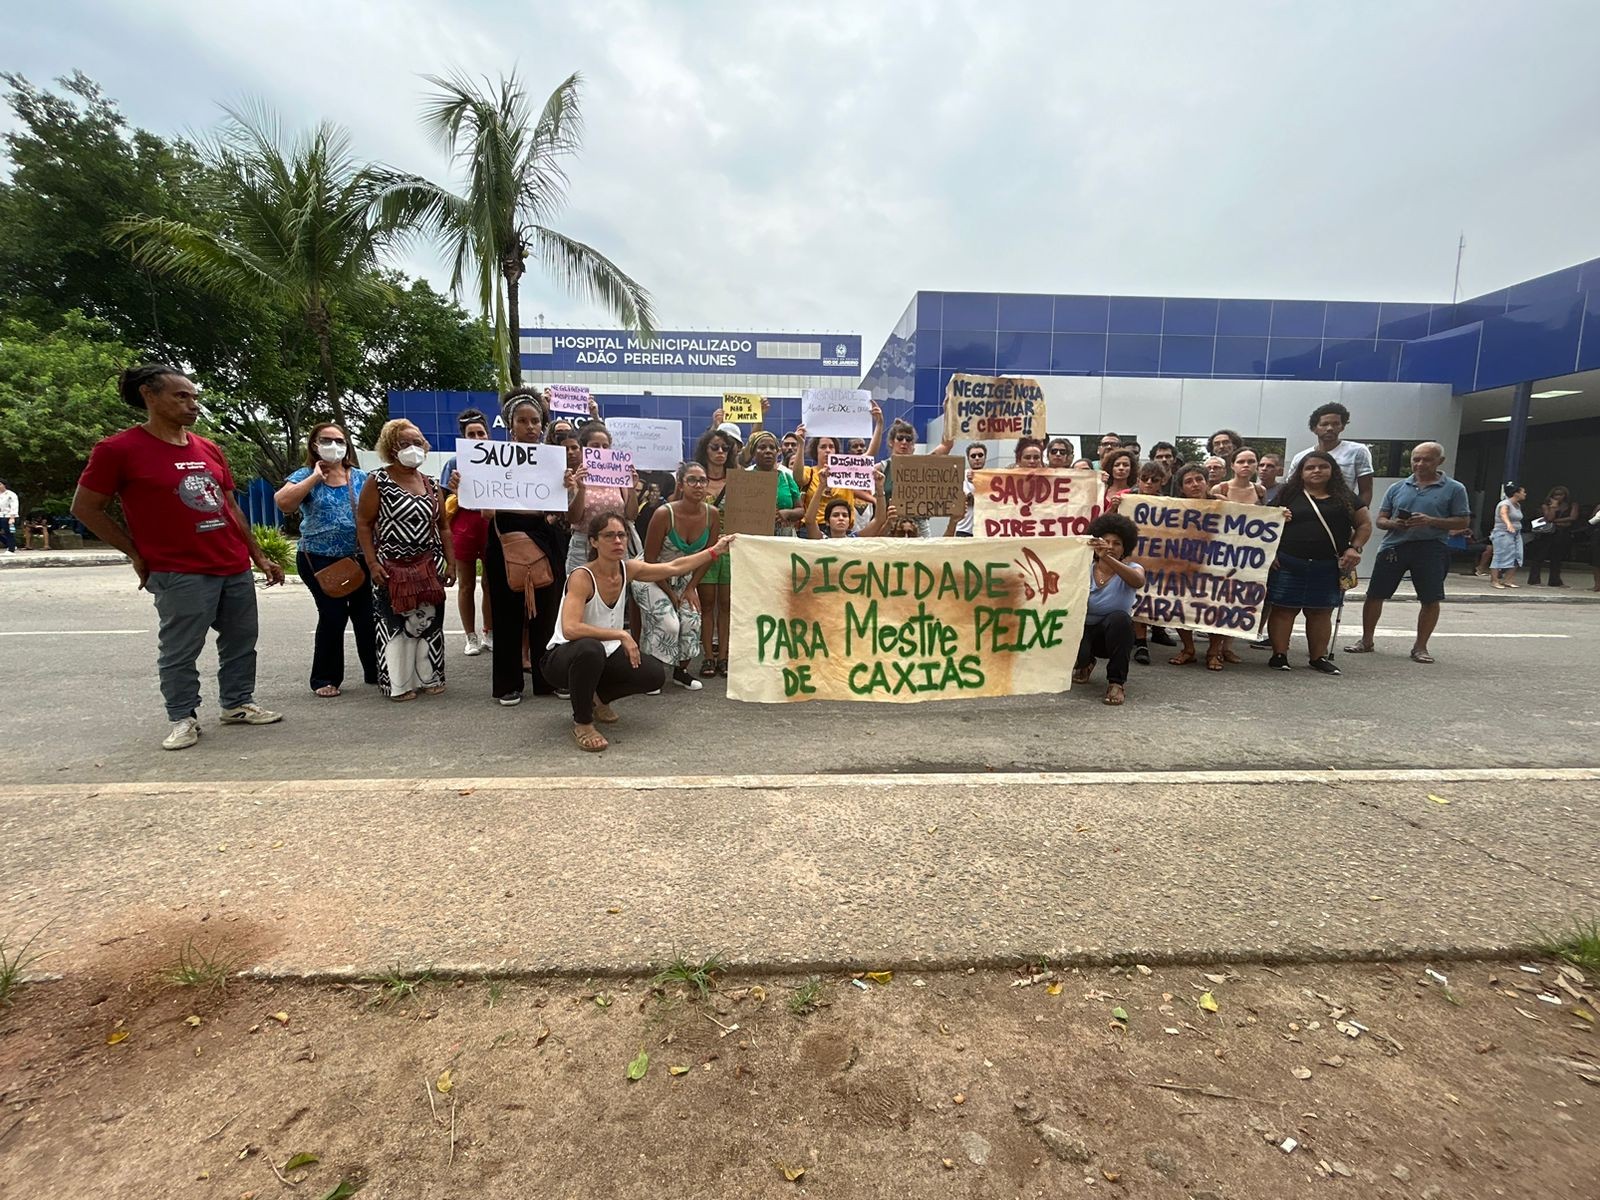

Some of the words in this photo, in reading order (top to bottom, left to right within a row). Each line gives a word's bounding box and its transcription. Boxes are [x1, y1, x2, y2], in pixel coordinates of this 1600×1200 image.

[554, 336, 624, 350] HOSPITAL
[627, 338, 752, 353] MUNICIPALIZADO
[576, 350, 618, 364] ADÃO
[624, 353, 684, 365] PEREIRA
[688, 354, 737, 366] NUNES
[953, 379, 1044, 401] NEGLIGÊNCIA
[958, 400, 1035, 418] HOSPITALAR
[977, 416, 1033, 435] CRIME!!
[470, 442, 538, 468] SAÚDE
[584, 448, 602, 460] PQ
[612, 450, 632, 462] NÃO
[586, 460, 622, 472] SEGUIRAM
[830, 456, 874, 467] DIGNIDADE
[897, 485, 959, 500] HOSPITALAR
[989, 472, 1072, 505] SAÚDE
[916, 500, 953, 516] CRIME
[1134, 502, 1280, 543] QUEREMOS
[1136, 536, 1266, 569] TENDIMENTO
[790, 552, 1011, 601] DIGNIDADE
[1144, 568, 1266, 607] MANITÁRIO
[1190, 602, 1258, 632] TODOS
[756, 614, 829, 662] PARA
[844, 599, 958, 657] Mestre
[974, 607, 1068, 653] PEIXE
[782, 664, 817, 697] DE
[848, 655, 985, 696] CAXIAS
